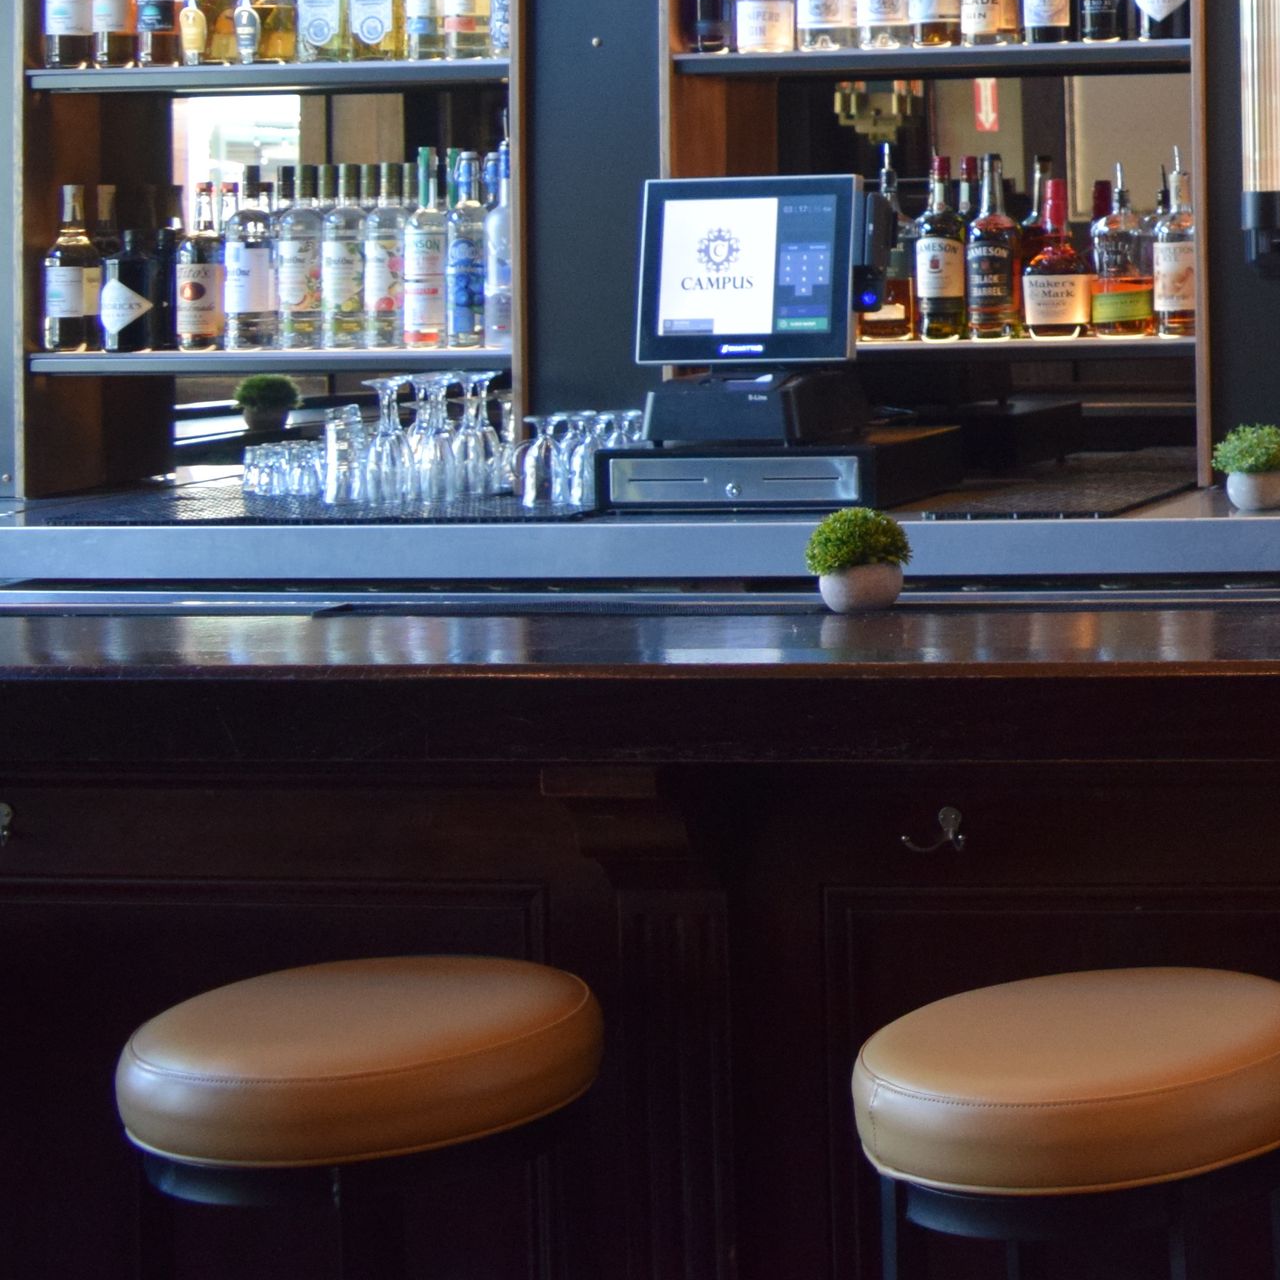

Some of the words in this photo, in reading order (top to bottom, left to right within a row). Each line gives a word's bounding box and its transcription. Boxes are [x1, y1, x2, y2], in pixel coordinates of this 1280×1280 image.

[919, 242, 957, 254] AMESON
[681, 275, 754, 290] CAMPUS
[1041, 289, 1075, 298] Mark
